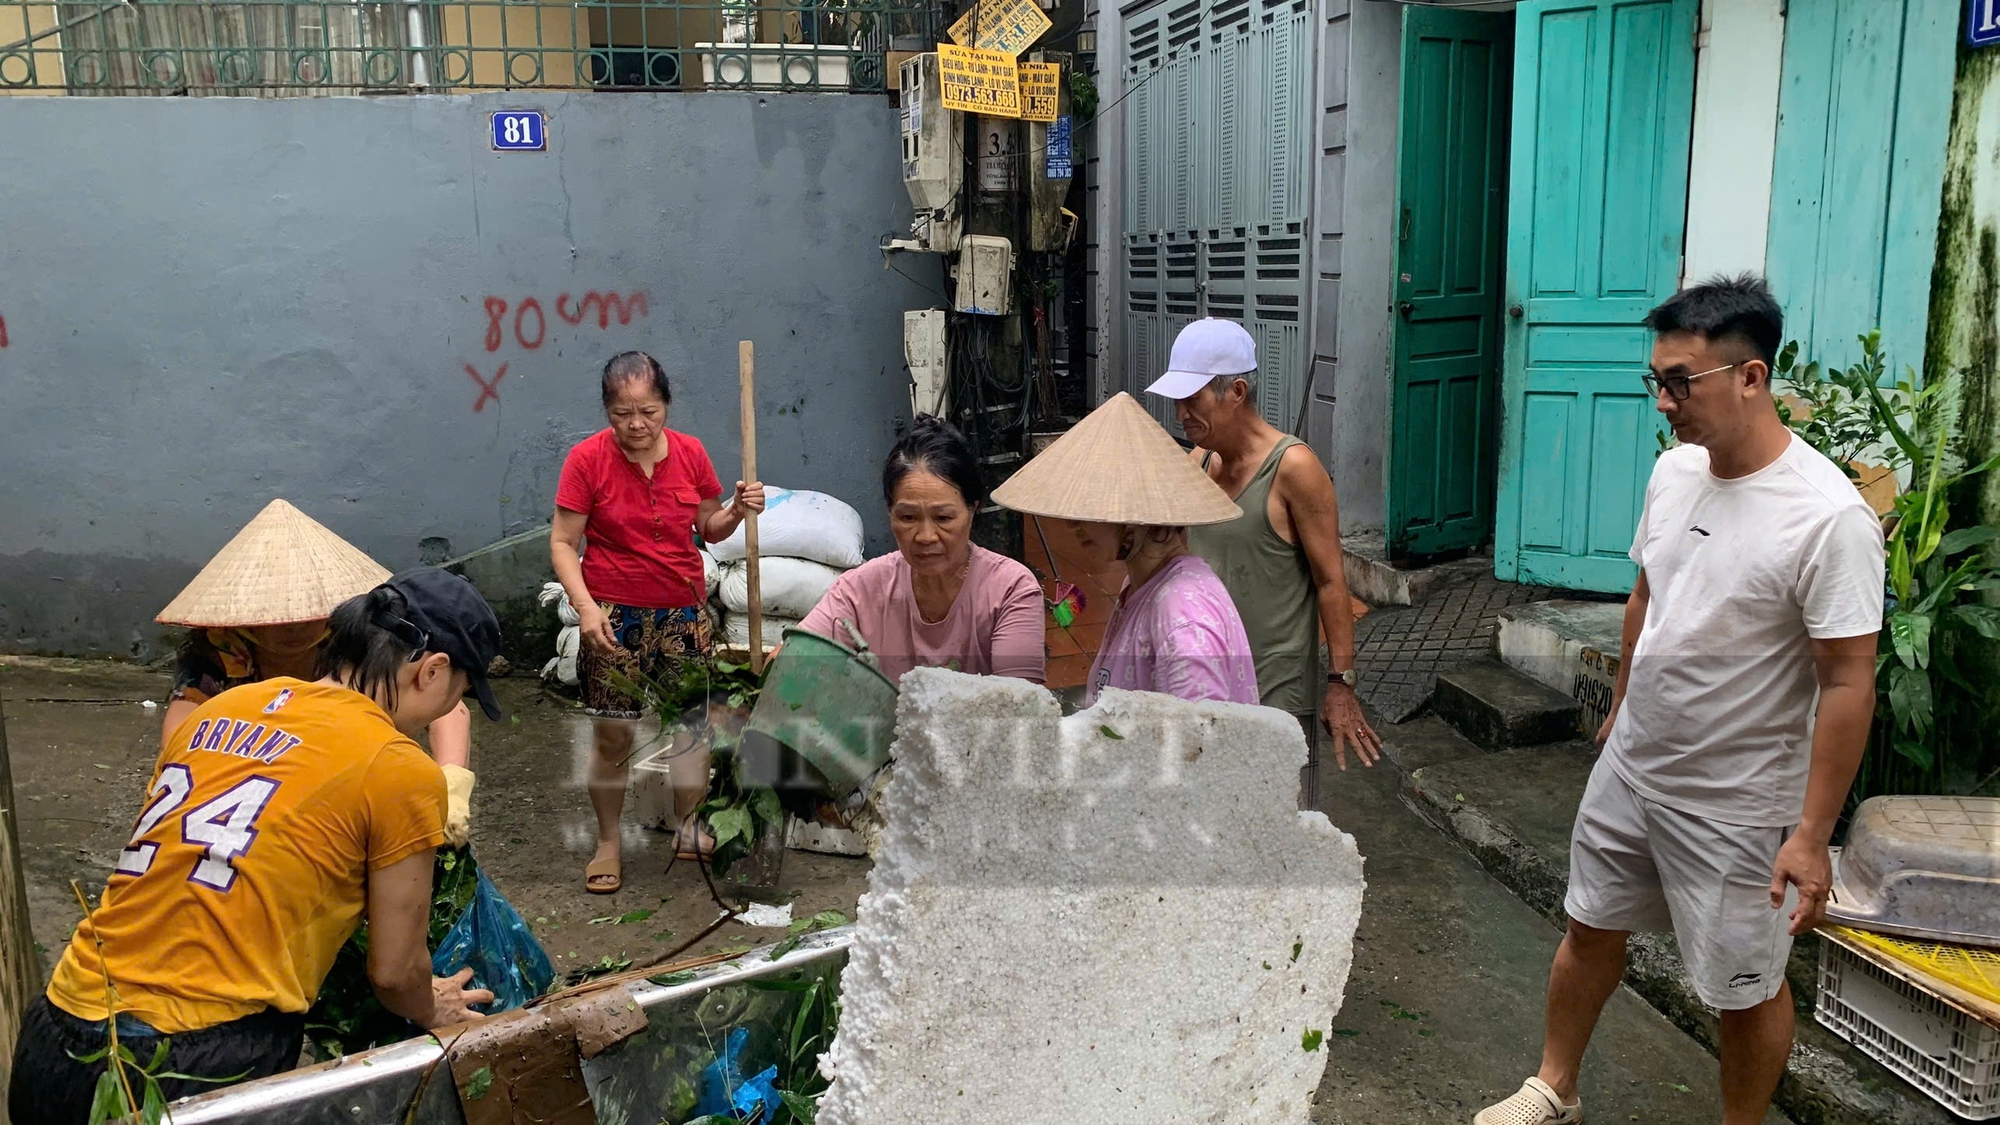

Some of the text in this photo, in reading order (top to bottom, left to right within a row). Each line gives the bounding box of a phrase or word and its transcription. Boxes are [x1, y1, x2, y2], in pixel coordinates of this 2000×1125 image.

[993, 11, 1042, 52] 3.563.668
[1979, 0, 2000, 31] 1
[949, 48, 967, 58] SỬA
[946, 84, 1016, 107] 0973.563.668
[504, 116, 534, 144] 81
[484, 289, 649, 352] 80 cm
[1574, 671, 1613, 718] 091620
[188, 717, 303, 765] BRYANT
[115, 762, 282, 893] 24
